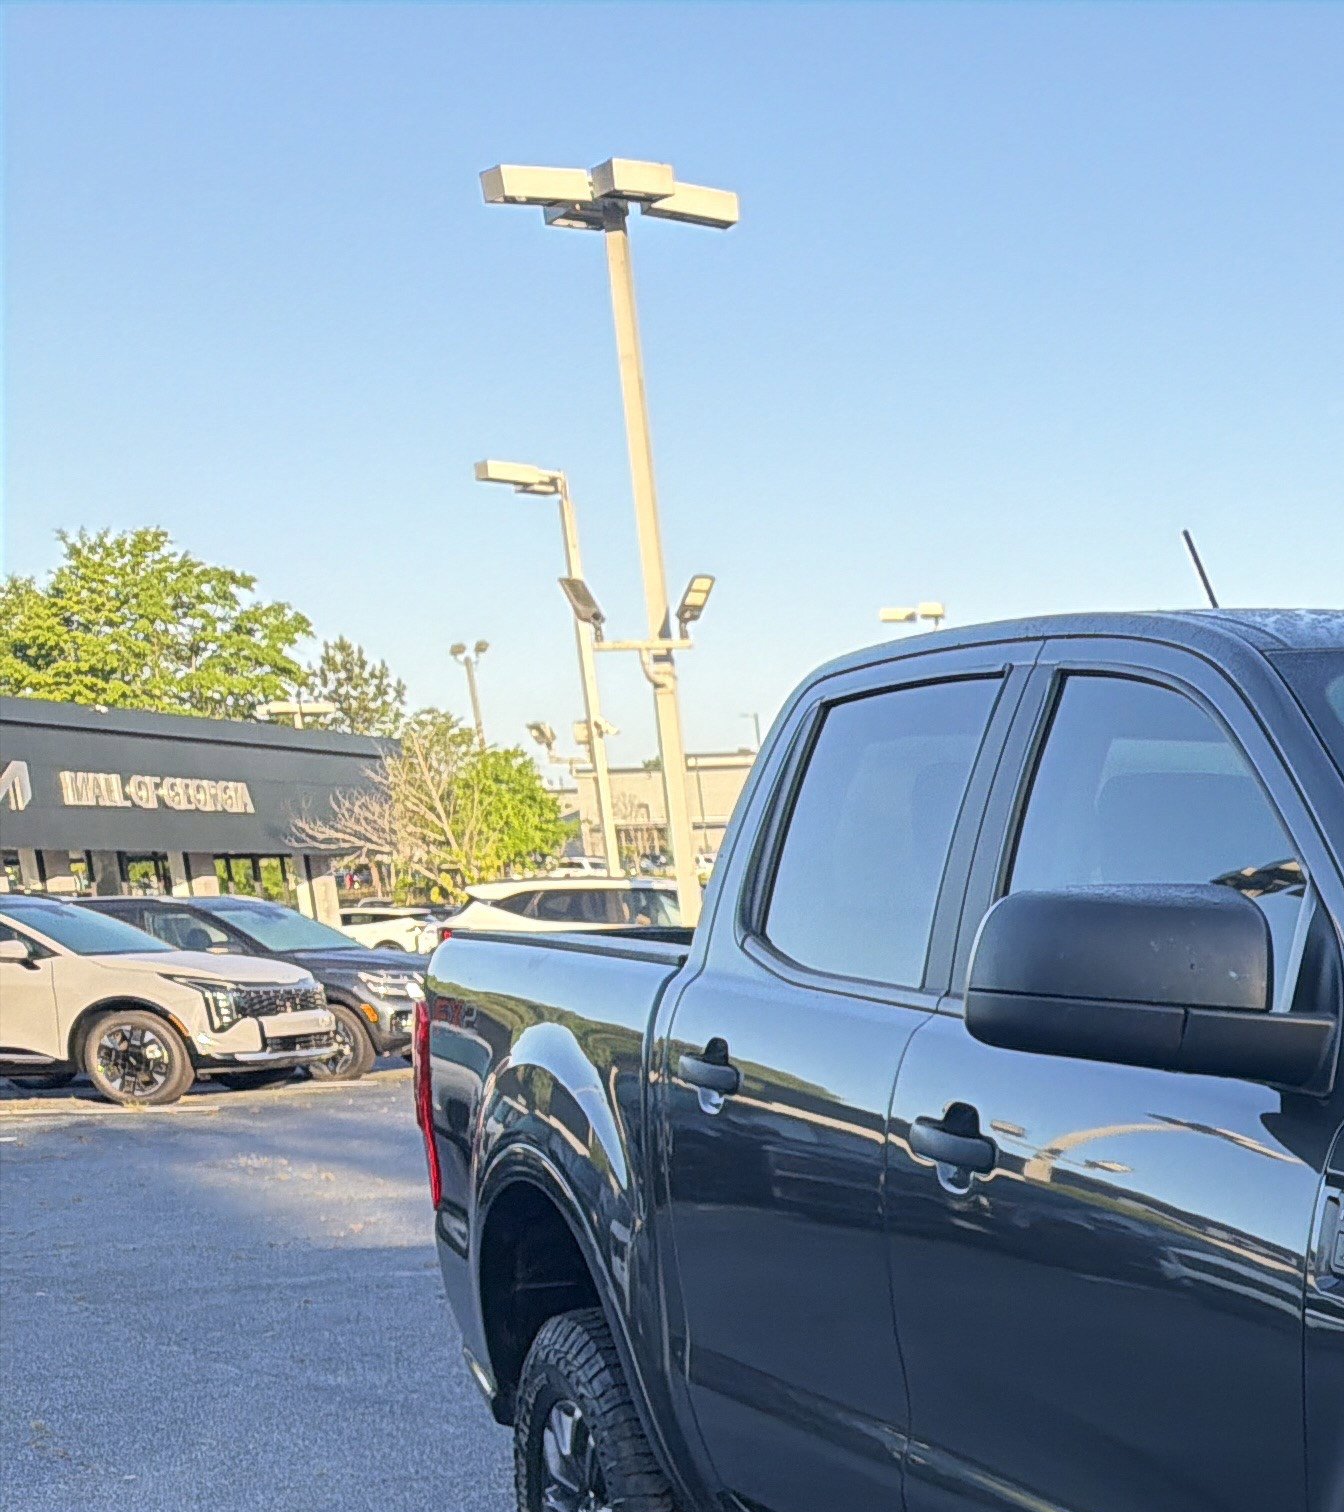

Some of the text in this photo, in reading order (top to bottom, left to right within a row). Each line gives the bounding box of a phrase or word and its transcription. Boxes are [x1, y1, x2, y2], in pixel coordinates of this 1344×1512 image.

[59, 770, 132, 807] MALL
[129, 774, 161, 808] OF
[162, 777, 256, 814] GEORGIA
